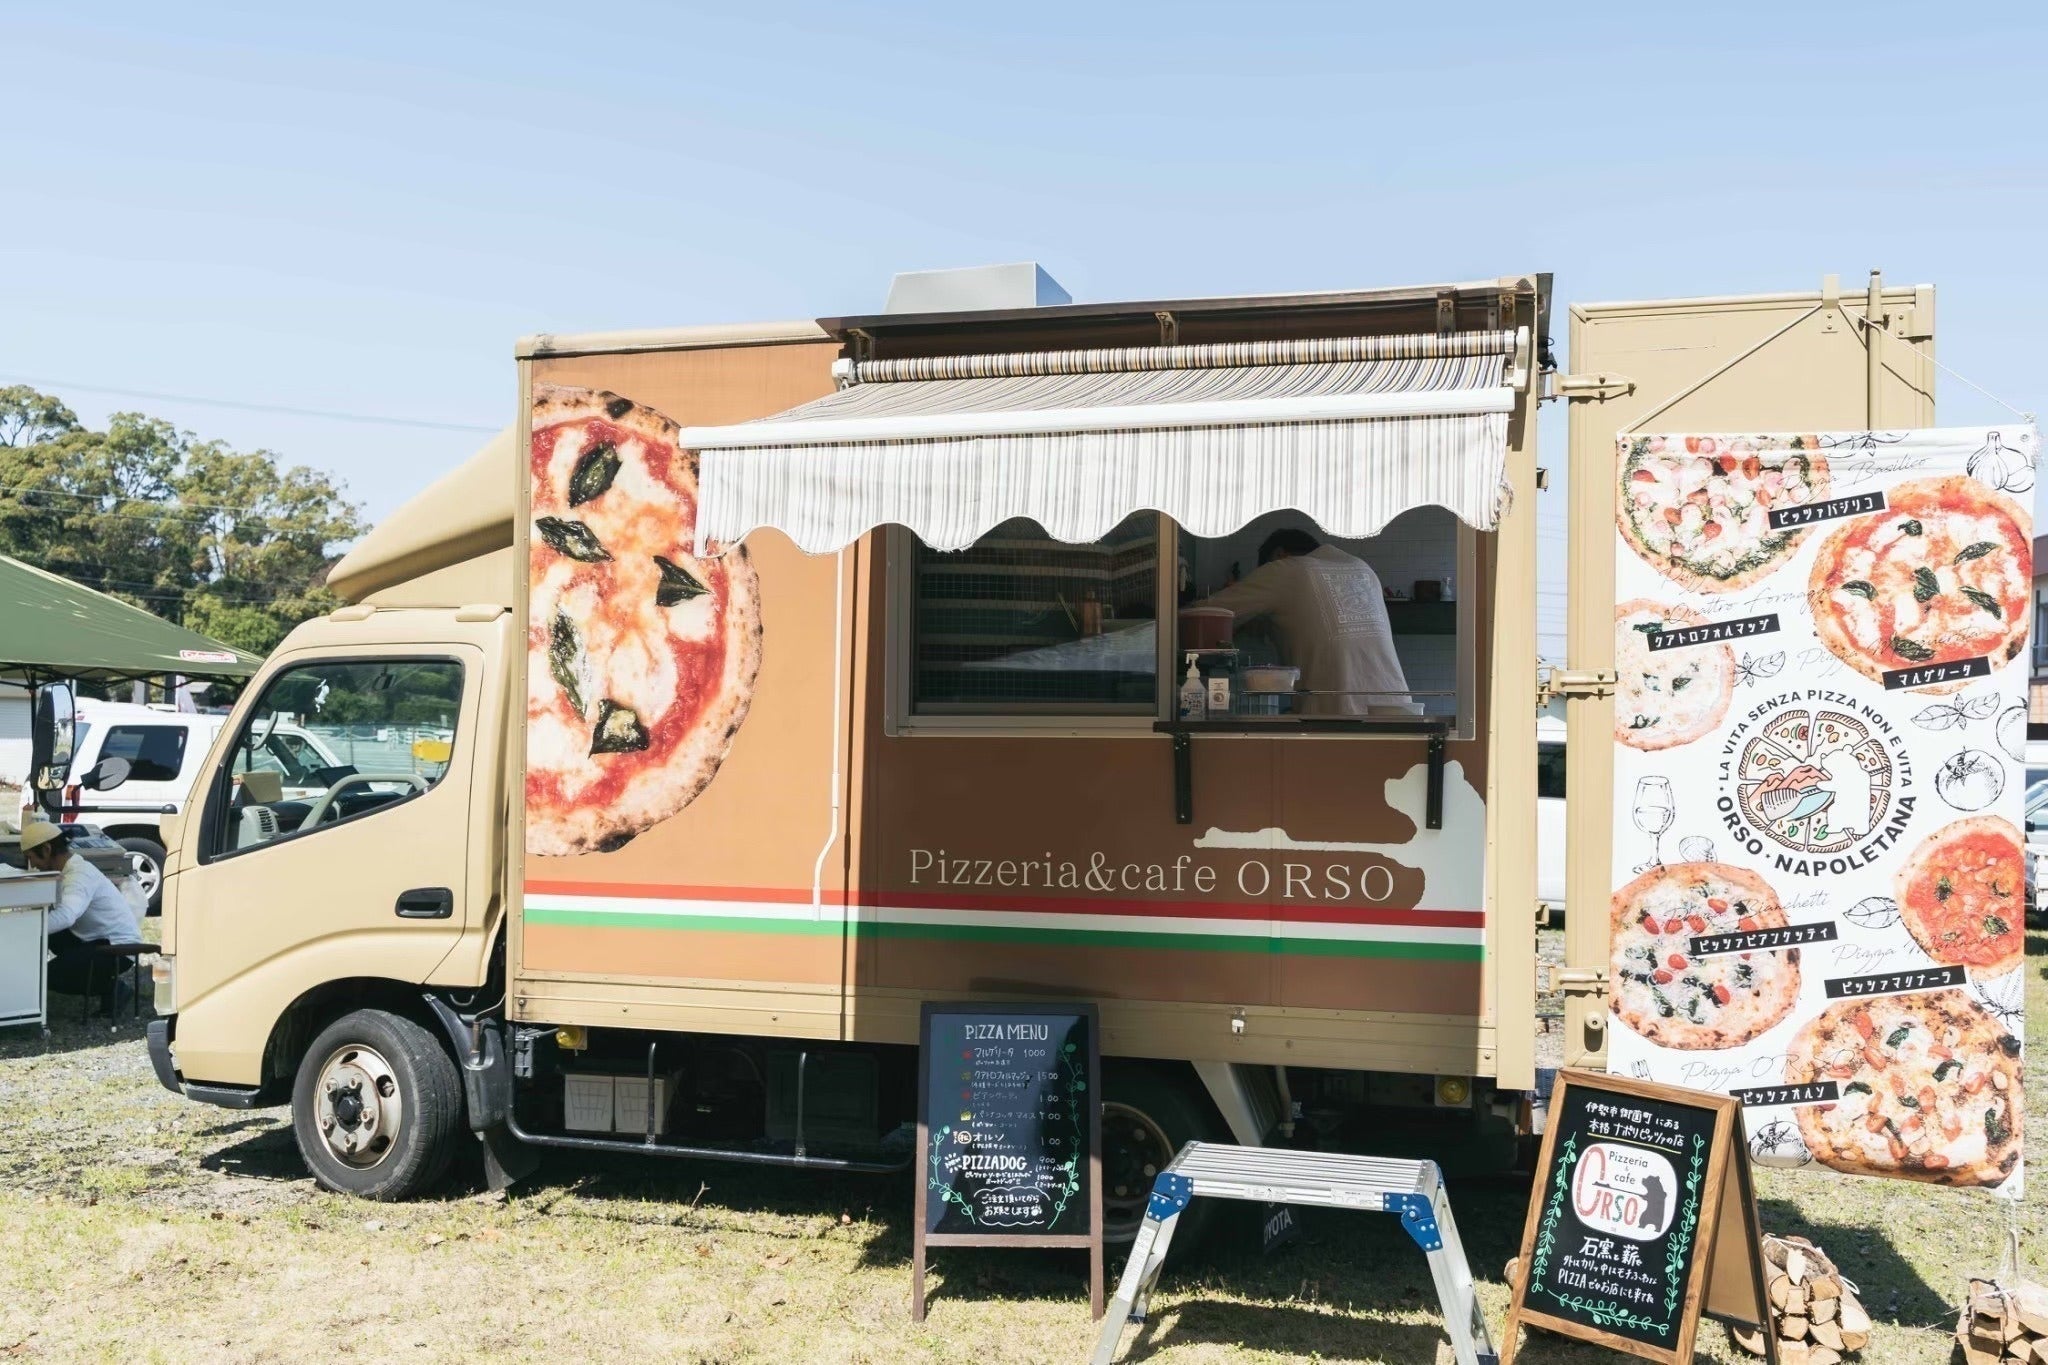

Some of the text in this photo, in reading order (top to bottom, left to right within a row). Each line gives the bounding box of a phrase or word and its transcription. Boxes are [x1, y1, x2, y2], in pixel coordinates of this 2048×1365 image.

[1898, 664, 1972, 686] マルゲリータ
[1718, 689, 1913, 788] LA VITA SENZA PIZZA NON E VITA
[1716, 795, 1917, 877] ORSO NAPOLETANA
[909, 849, 1394, 902] Pizzeria&cafe ORSO
[1831, 943, 1897, 974] Pizza
[1842, 971, 1951, 994] ピッツァマリナーラ
[965, 1024, 1048, 1040] PIZZA MENU
[1024, 1049, 1046, 1058] 1000
[1681, 1061, 1743, 1091] Pizza
[1743, 1086, 1825, 1105] ピッツァオルソ
[1609, 1151, 1649, 1168] Pizzeria
[1614, 1173, 1636, 1184] cafe
